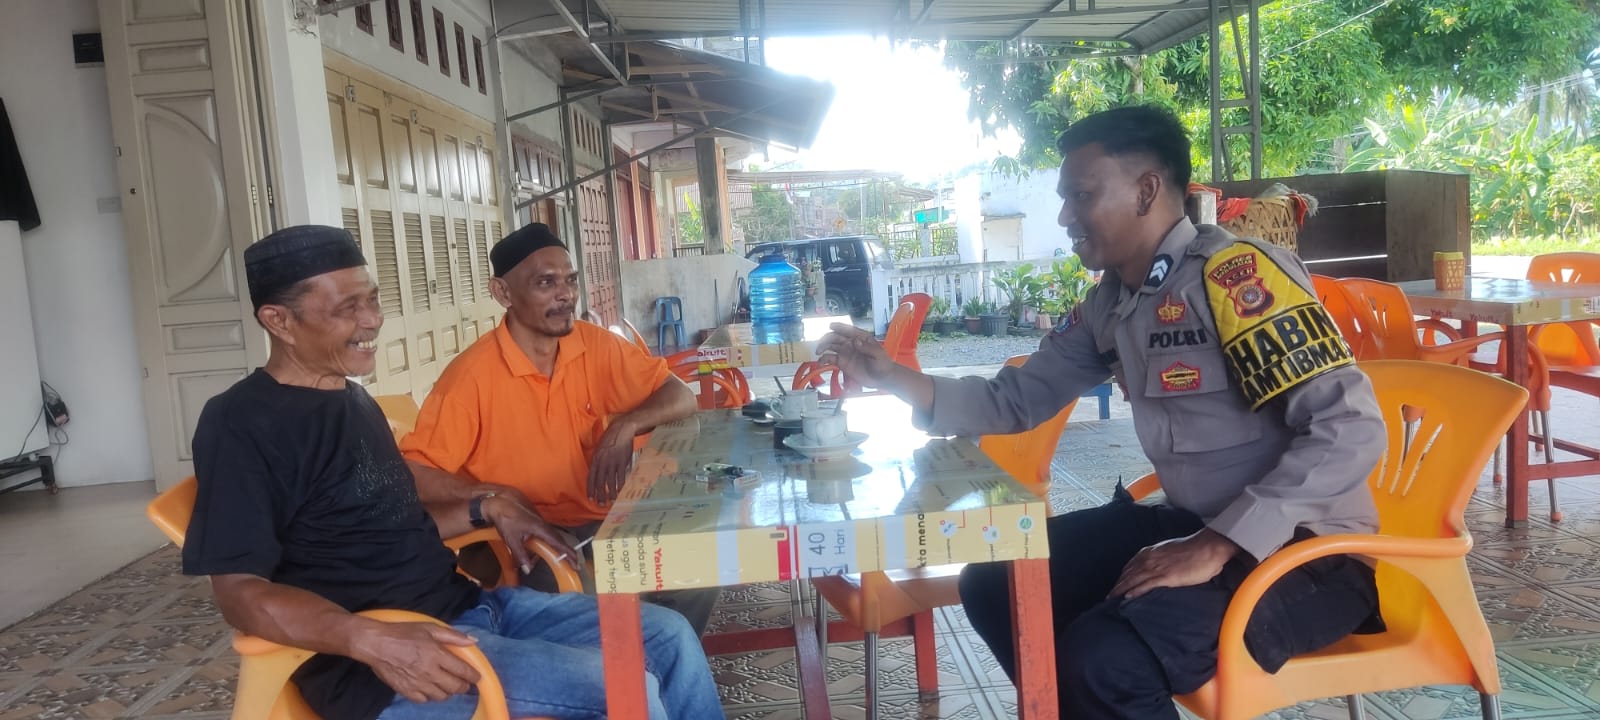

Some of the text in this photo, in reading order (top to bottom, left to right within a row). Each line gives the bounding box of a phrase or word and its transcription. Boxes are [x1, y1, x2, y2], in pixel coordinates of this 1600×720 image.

[1225, 267, 1253, 286] ACEH
[1149, 328, 1208, 348] POLRI
[1227, 305, 1340, 378] HABIN
[697, 348, 727, 358] akult
[1242, 337, 1354, 401] AMTIBMA
[917, 512, 926, 546] mena
[807, 532, 826, 556] 40
[833, 529, 846, 556] Hari
[606, 539, 617, 595] tetap terjag
[621, 550, 631, 573] agar
[639, 562, 648, 586] suhu
[653, 547, 665, 591] Yakult
